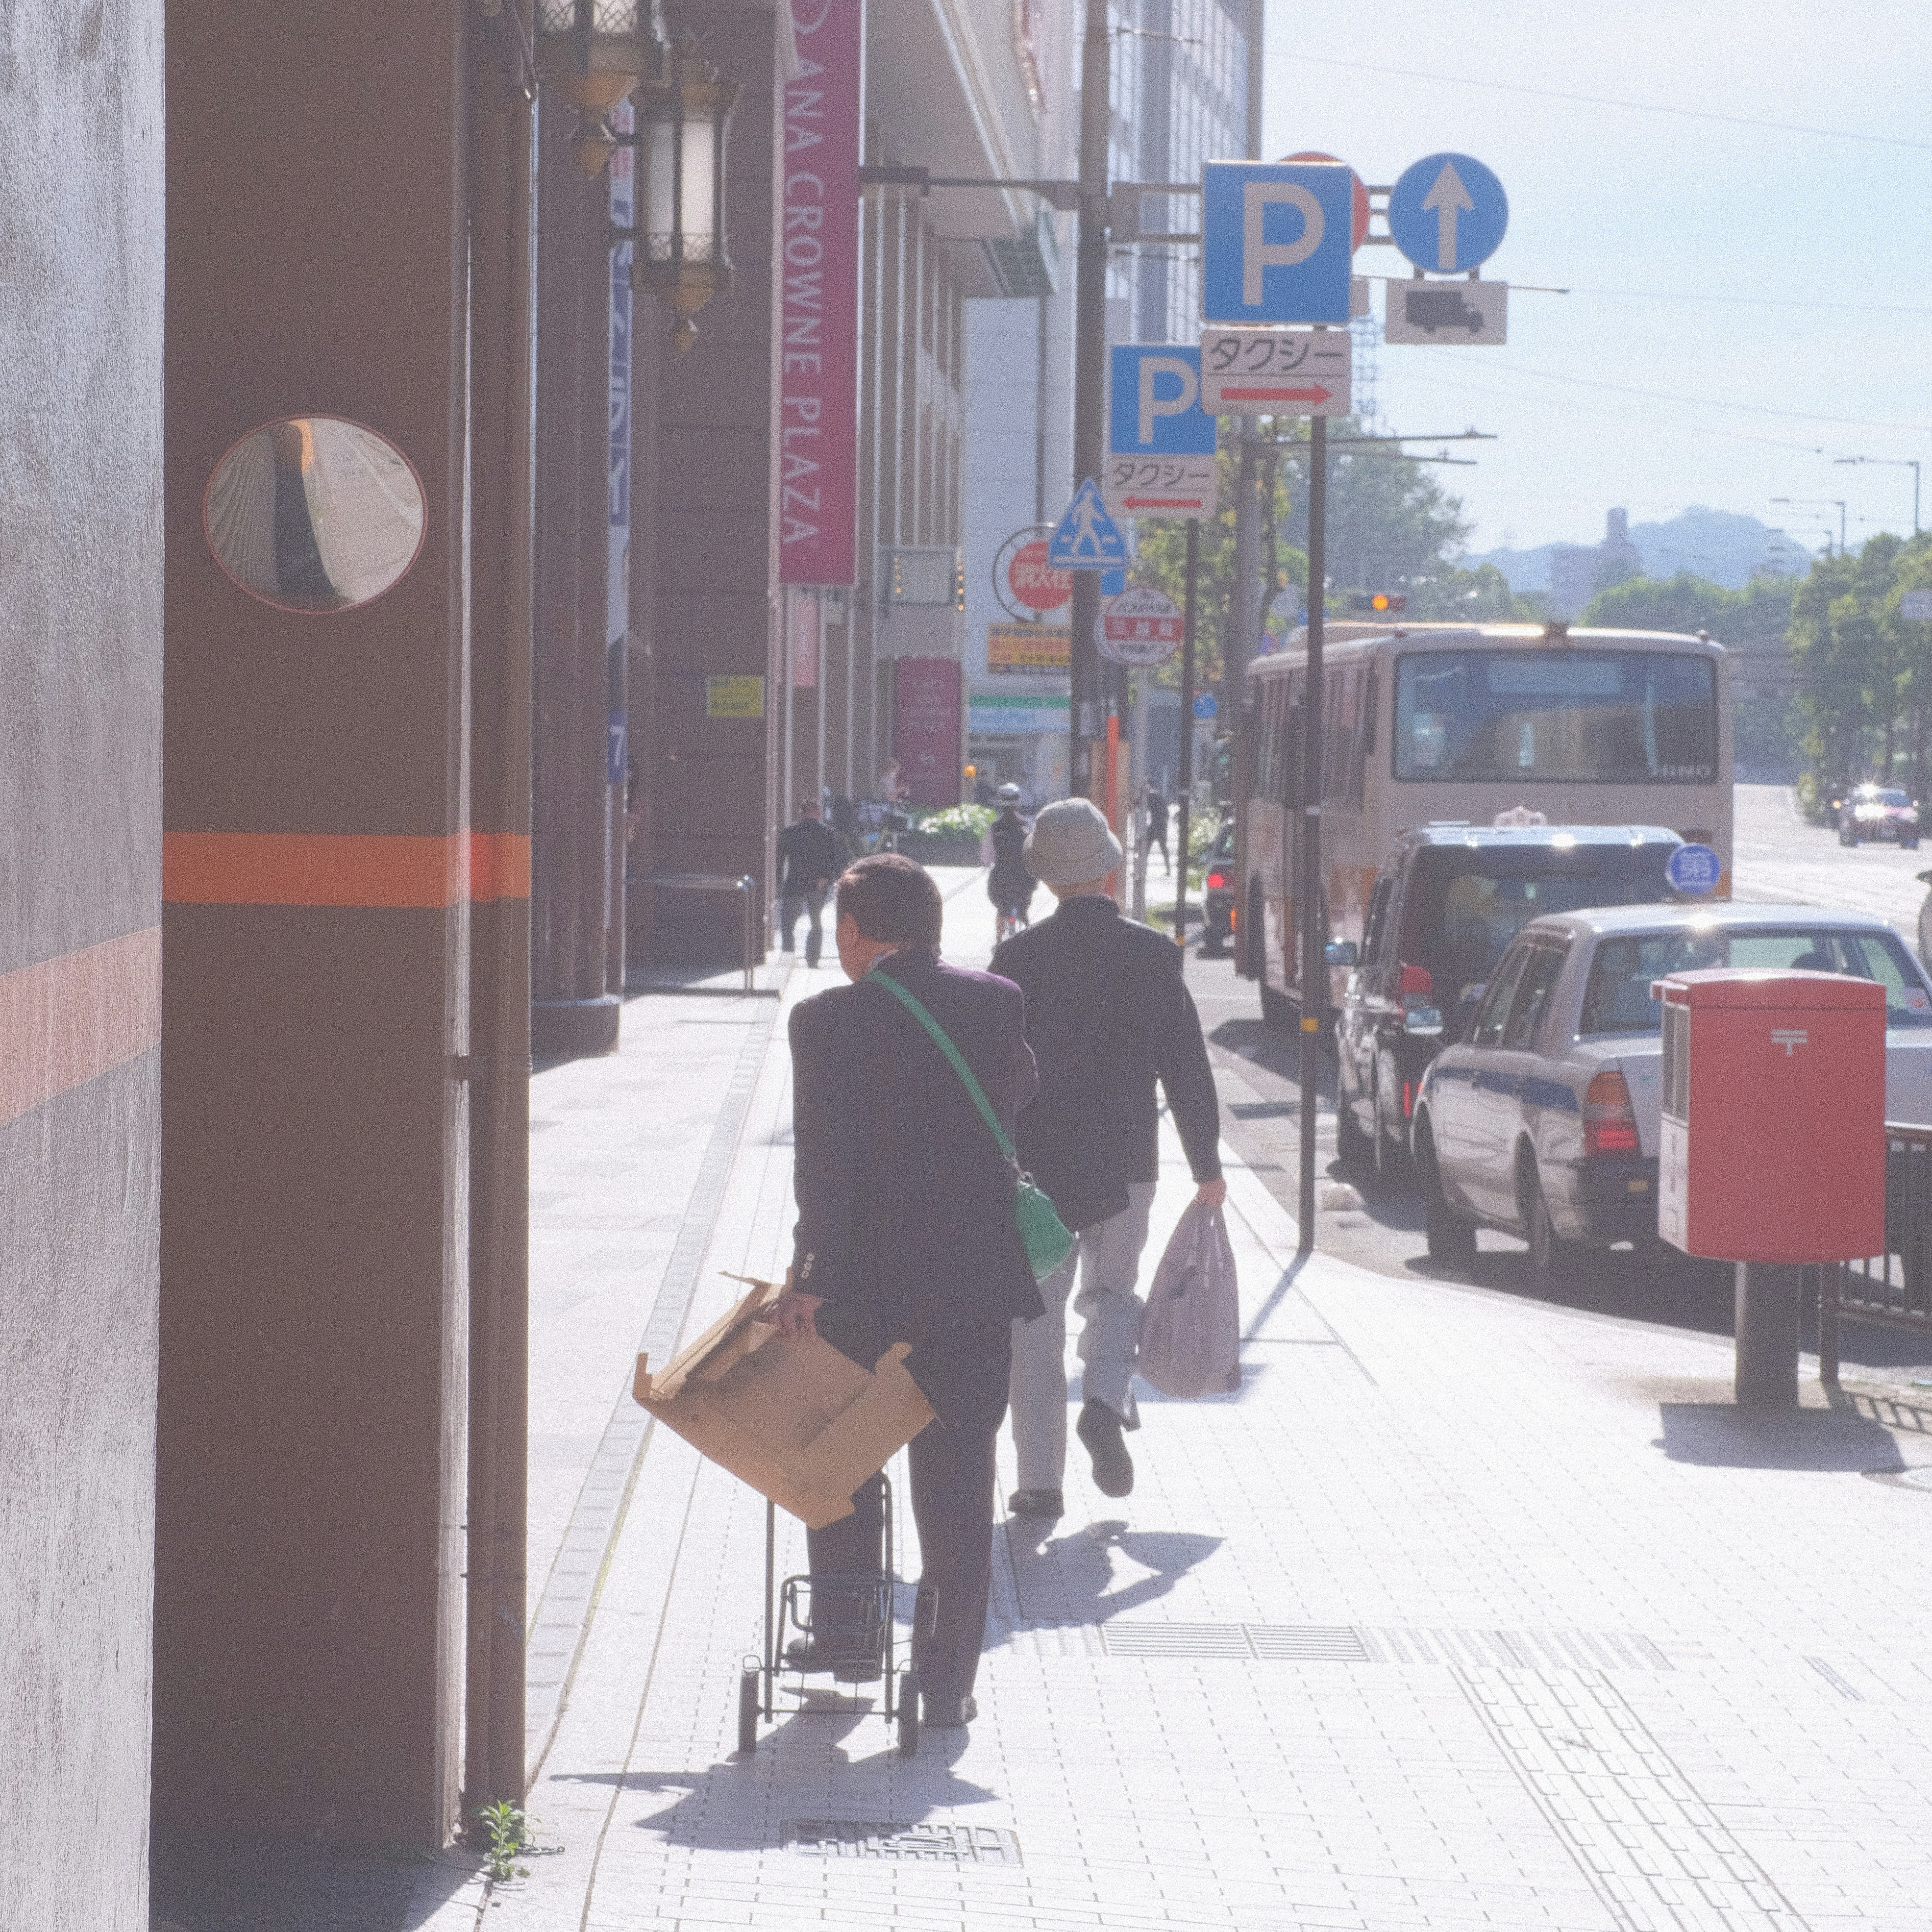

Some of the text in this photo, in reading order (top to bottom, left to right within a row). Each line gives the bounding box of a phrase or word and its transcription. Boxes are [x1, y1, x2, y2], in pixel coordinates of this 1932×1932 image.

[1243, 182, 1325, 306] P
[783, 57, 823, 544] ANA CROWNE PLAZA
[1210, 339, 1343, 371] タクシー
[1139, 358, 1198, 444] P
[1113, 464, 1210, 487] タクシー
[1651, 765, 1711, 777] HINO
